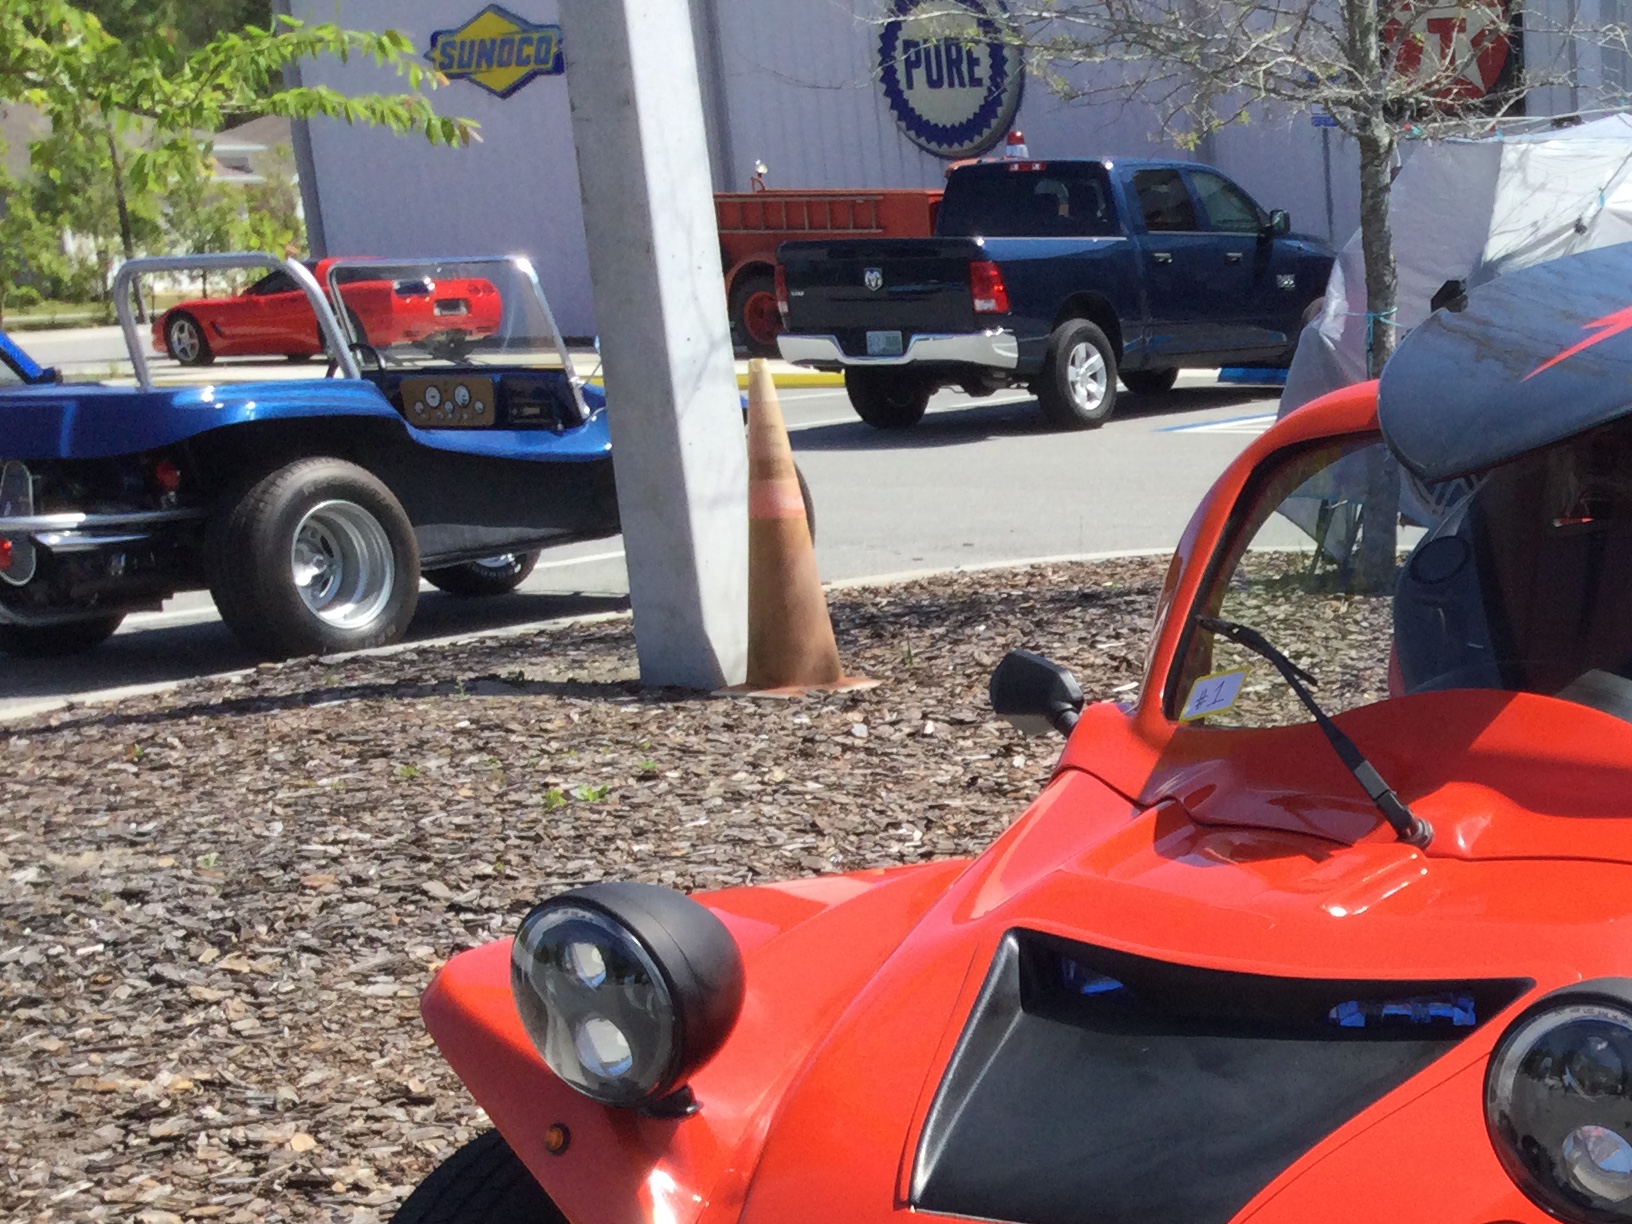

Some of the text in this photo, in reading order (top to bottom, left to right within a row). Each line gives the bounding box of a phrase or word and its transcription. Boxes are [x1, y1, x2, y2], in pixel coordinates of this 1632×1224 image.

[438, 35, 552, 70] SUNOCO
[902, 36, 983, 90] PURE
[1194, 680, 1226, 711] #1
